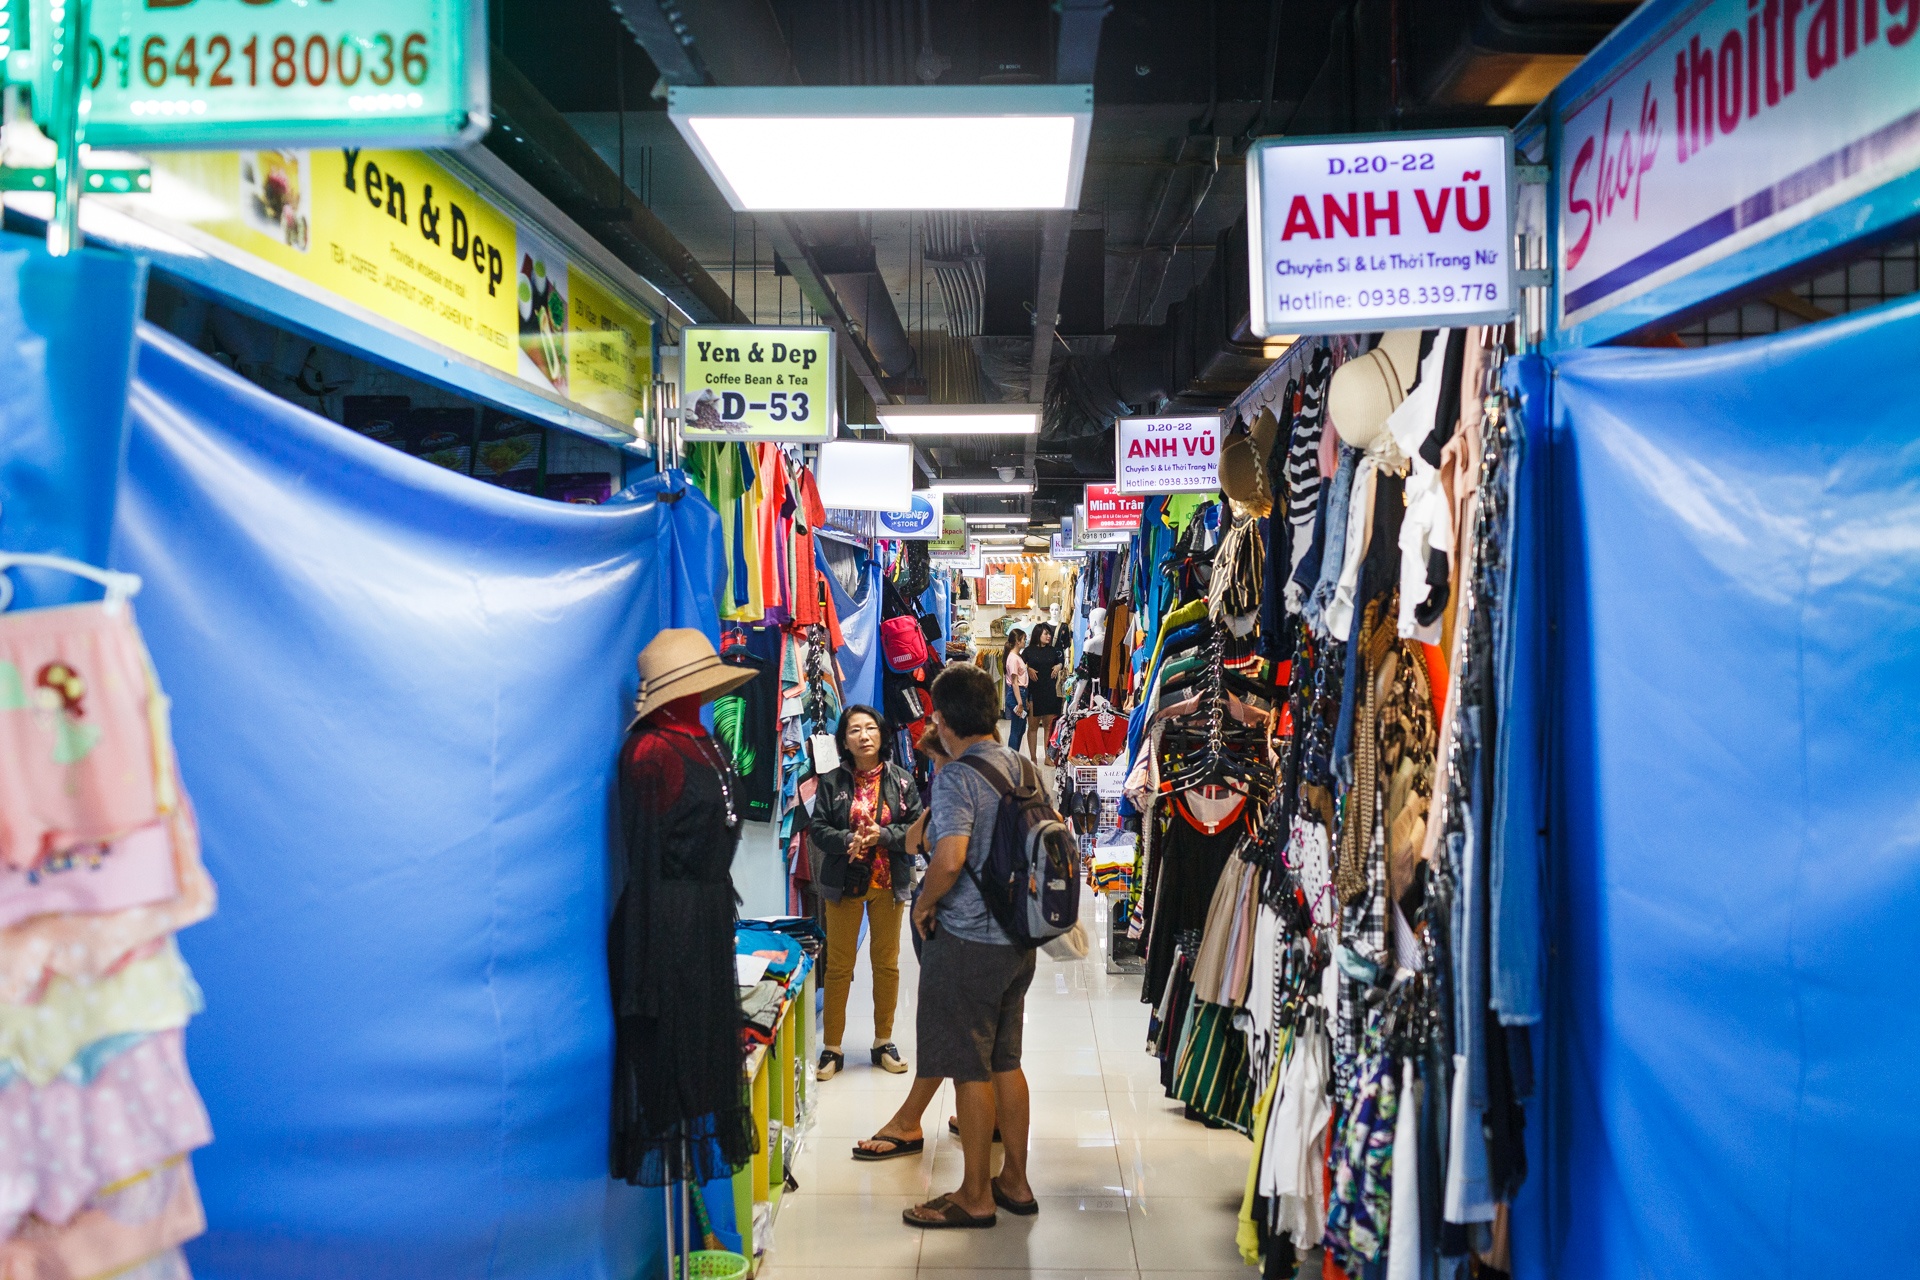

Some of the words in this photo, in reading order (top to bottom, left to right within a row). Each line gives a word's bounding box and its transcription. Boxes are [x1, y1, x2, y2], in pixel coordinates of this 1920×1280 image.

[1328, 153, 1435, 175] D.20-22
[1568, 80, 1662, 270] Shop
[1281, 190, 1400, 241] ANH
[1413, 170, 1491, 234] VŨ
[341, 148, 408, 226] Yen
[420, 184, 440, 247] &
[450, 201, 503, 298] Dep
[1276, 258, 1333, 279] Chuyên
[1355, 256, 1366, 271] &
[1390, 253, 1424, 269] Thời
[1427, 251, 1471, 271] Trang
[1475, 249, 1499, 265] Nữ
[1279, 292, 1352, 311] Hotline:
[1358, 283, 1498, 308] 0938.339.778
[697, 341, 740, 362] Yen
[748, 342, 764, 362] &
[772, 343, 817, 369] Dep
[705, 373, 740, 385] Coffee
[744, 374, 772, 385] Bean
[776, 375, 784, 385] &
[788, 374, 808, 385] Tea
[721, 391, 810, 422] D-53
[1147, 423, 1192, 432] D.20-22
[1127, 438, 1177, 459] ANH
[1183, 430, 1215, 456] VŨ
[1125, 465, 1149, 474] Chuyên
[1188, 463, 1206, 472] Trang
[1126, 479, 1157, 487] Hotline:
[1159, 476, 1217, 486] 0938.339.778
[1089, 500, 1116, 511] Minh
[897, 520, 918, 528] STORE
